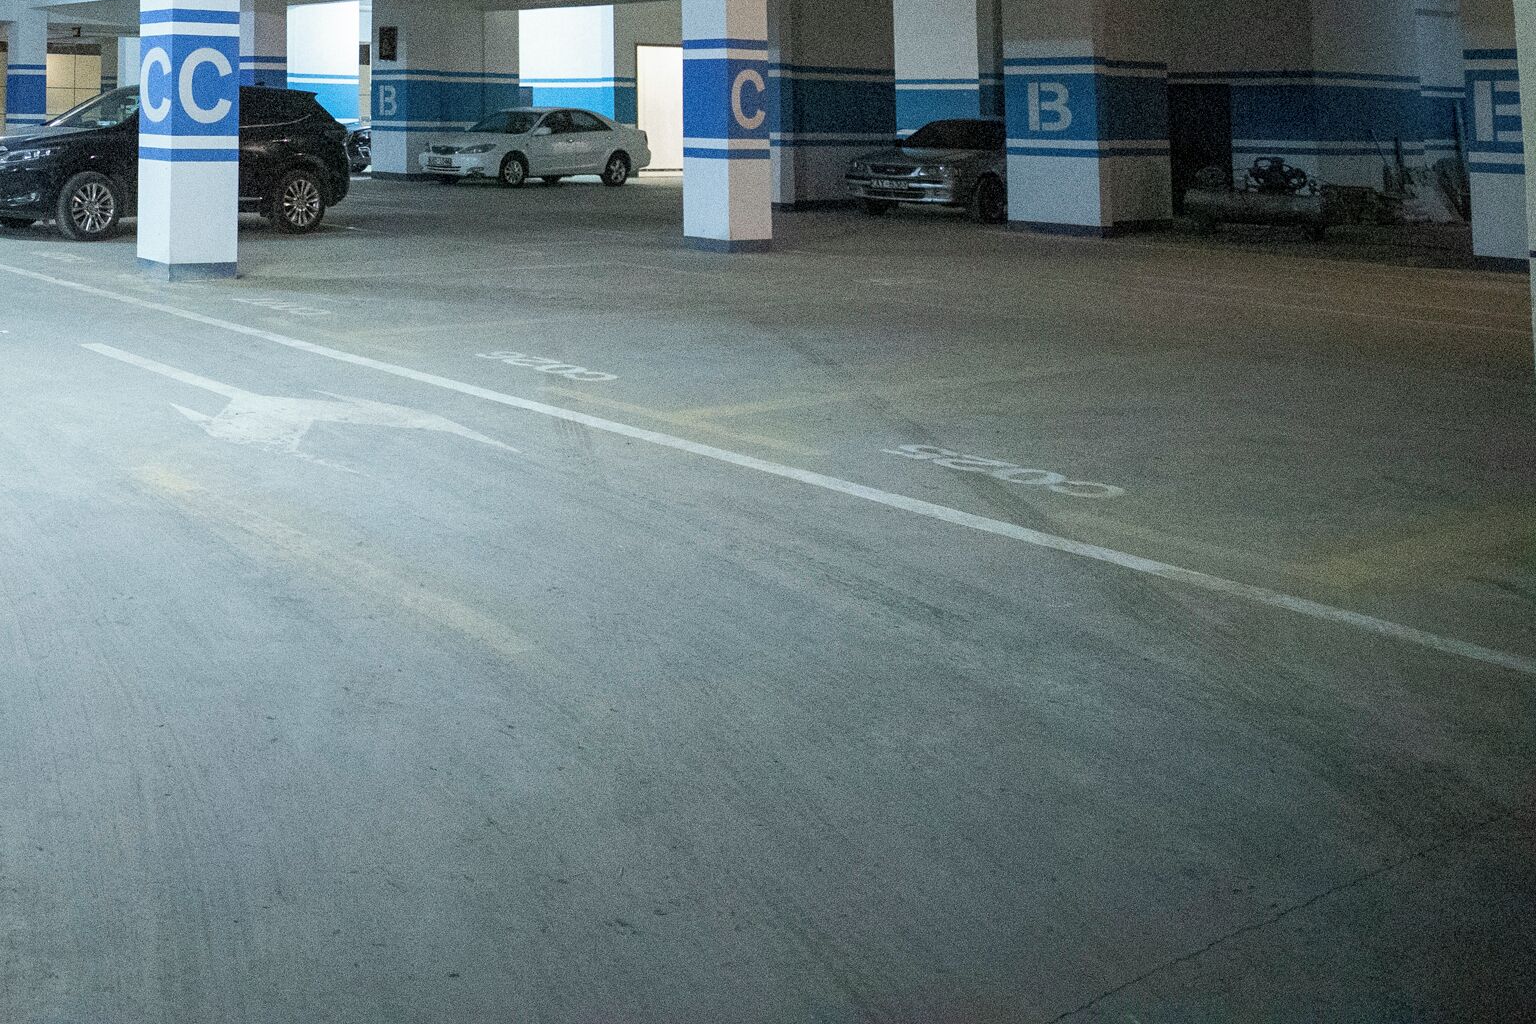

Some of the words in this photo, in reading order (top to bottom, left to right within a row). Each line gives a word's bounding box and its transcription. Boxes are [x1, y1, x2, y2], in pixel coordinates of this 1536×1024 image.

[140, 47, 172, 123] C
[178, 47, 233, 124] C
[378, 84, 398, 116] B
[731, 69, 766, 130] C
[1028, 81, 1073, 131] B
[880, 443, 1126, 499] C025
